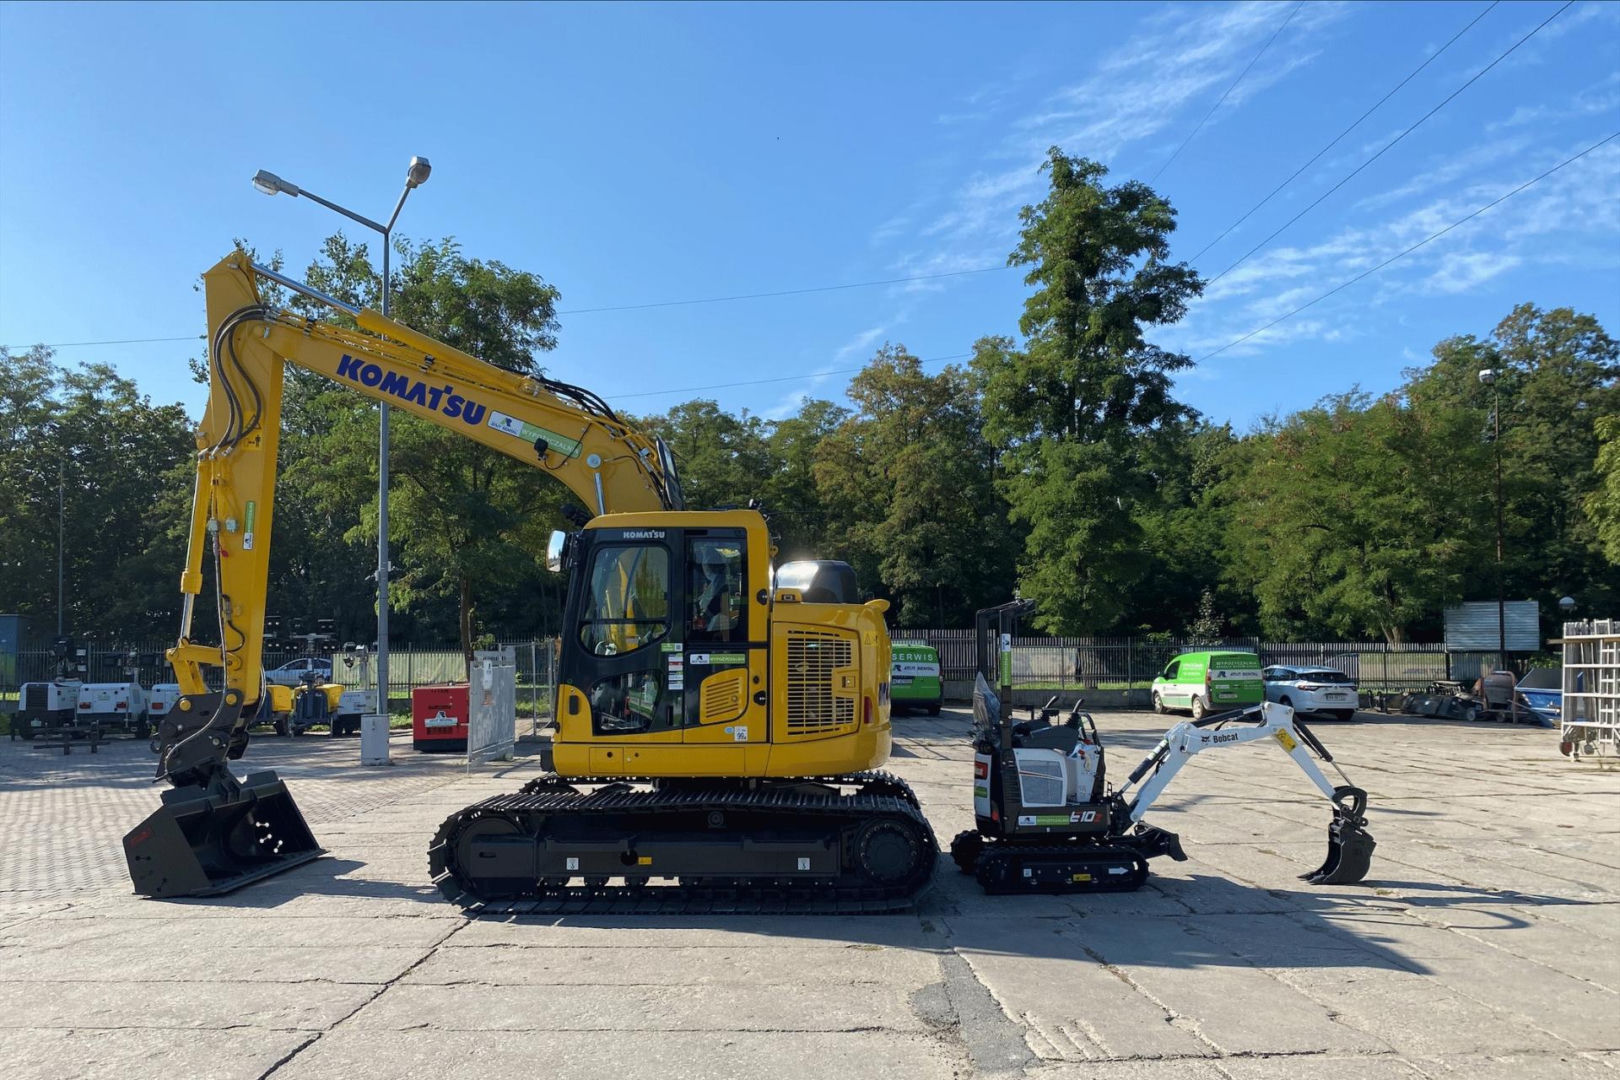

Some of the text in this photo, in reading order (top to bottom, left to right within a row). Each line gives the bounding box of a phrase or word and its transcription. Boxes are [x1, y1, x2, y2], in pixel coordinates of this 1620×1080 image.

[336, 354, 487, 425] KOMATSU
[623, 529, 666, 539] KOMATSU
[891, 653, 934, 662] SERWIS
[1212, 732, 1239, 744] Bobcat
